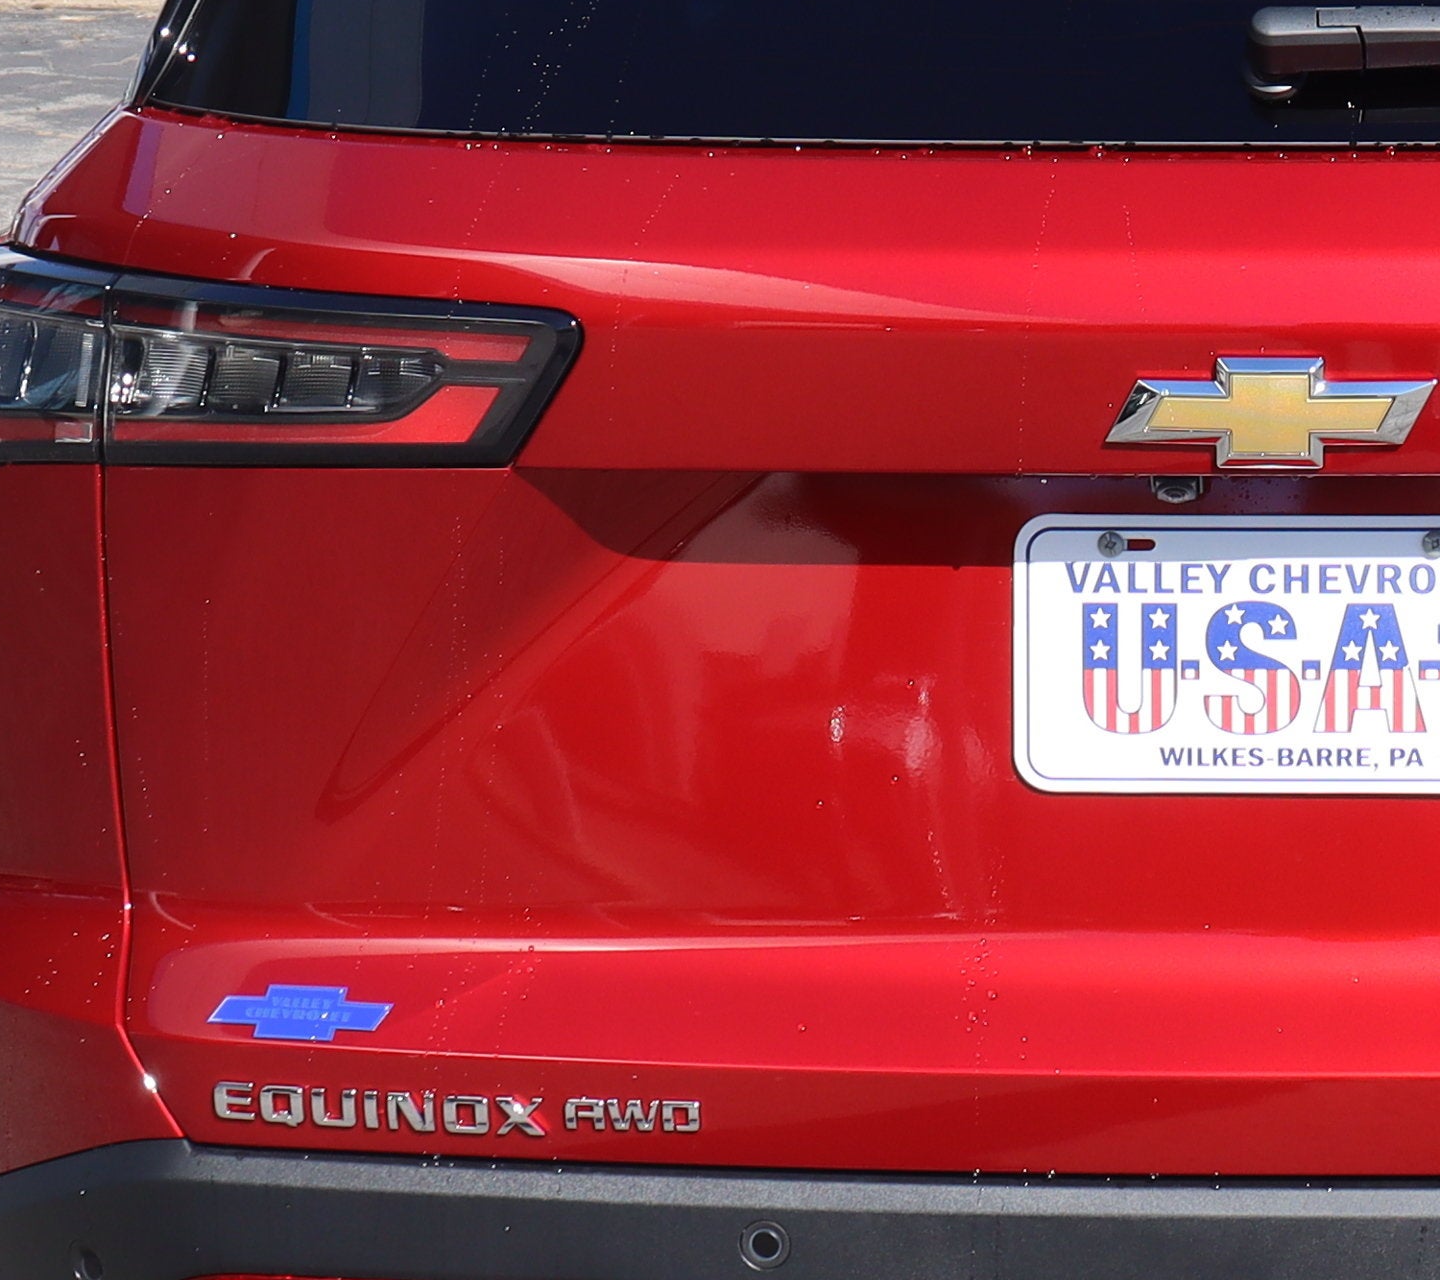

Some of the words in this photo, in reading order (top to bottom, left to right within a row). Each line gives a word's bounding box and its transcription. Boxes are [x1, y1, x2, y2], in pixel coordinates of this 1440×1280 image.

[1065, 562, 1234, 594] VALLEY
[1159, 747, 1379, 770] WILKES-BARRE,
[1389, 747, 1425, 767] PA
[271, 996, 334, 1010] VALLEY
[212, 1081, 546, 1137] EQUINOX
[564, 1097, 701, 1132] AWD
